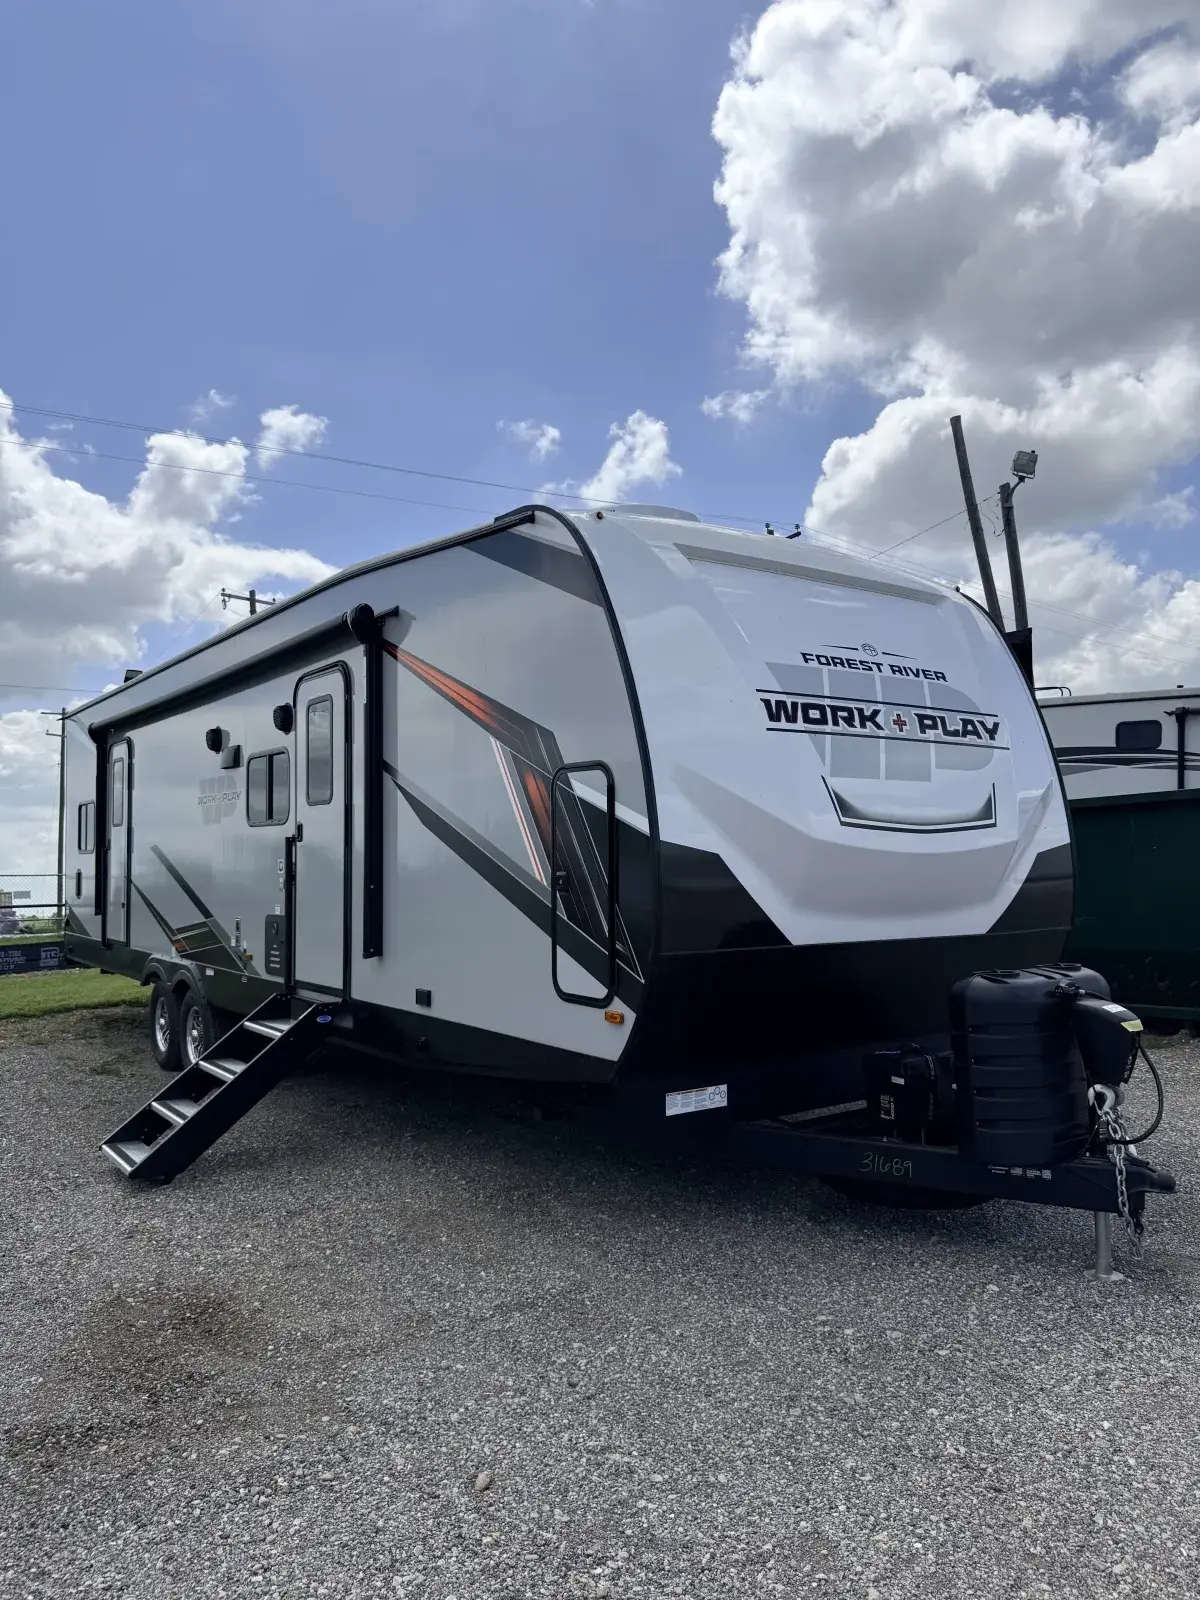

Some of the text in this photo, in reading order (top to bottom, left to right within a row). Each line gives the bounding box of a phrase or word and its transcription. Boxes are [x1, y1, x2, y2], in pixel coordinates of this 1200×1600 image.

[799, 651, 949, 683] FOREST RIVER
[759, 697, 885, 731] WORK
[913, 712, 1000, 742] PLAY
[223, 791, 242, 802] PLAY
[859, 1151, 913, 1179] 31689
